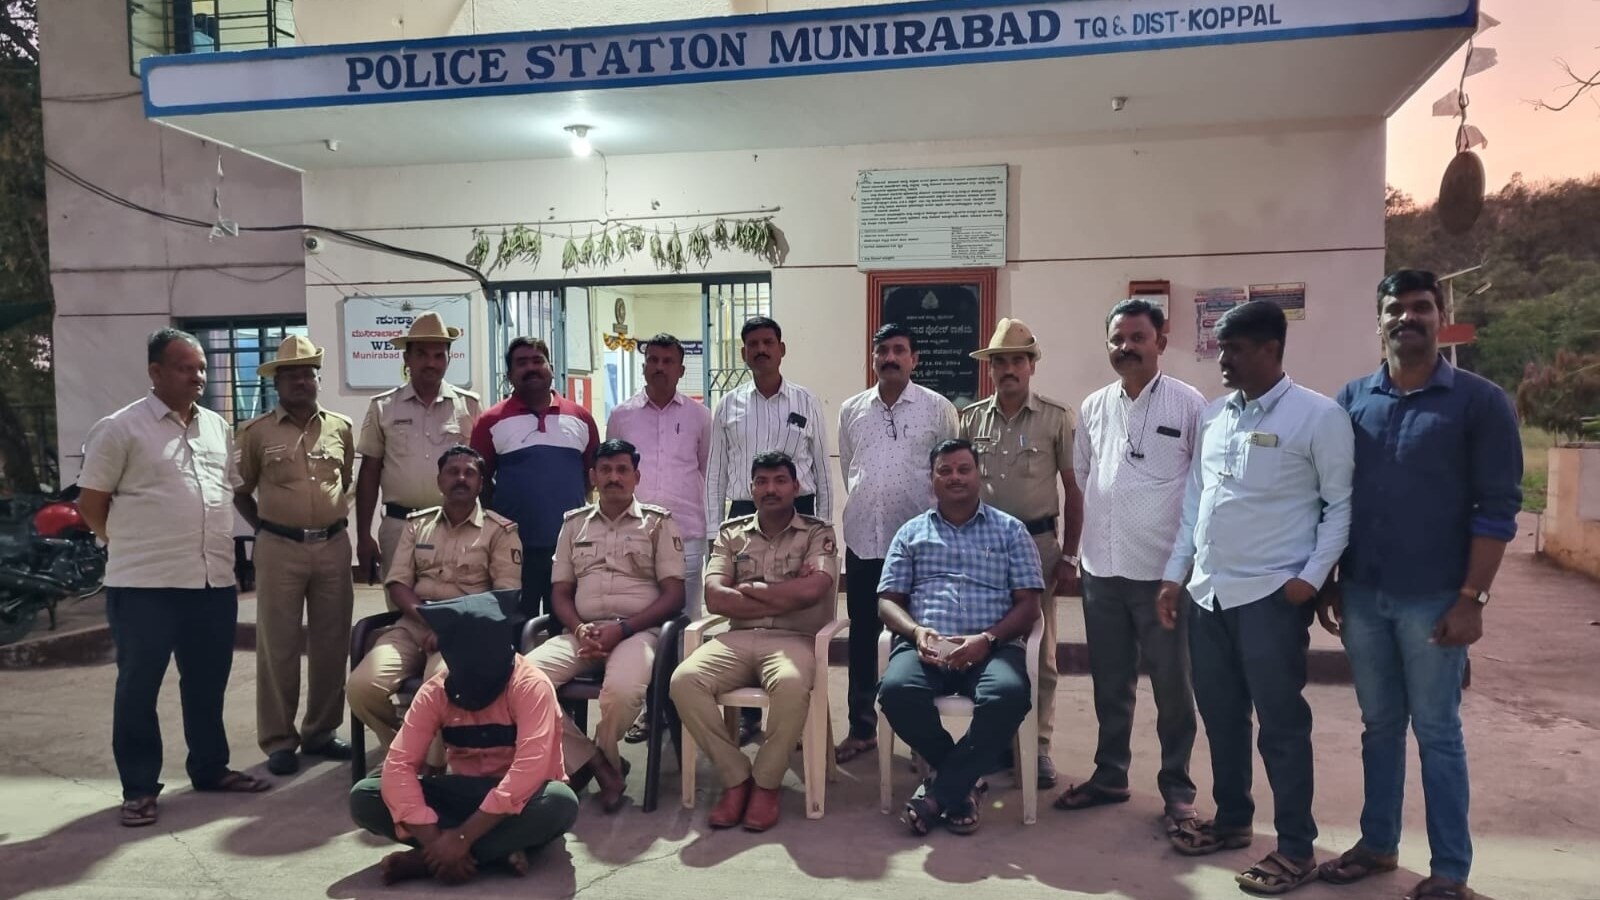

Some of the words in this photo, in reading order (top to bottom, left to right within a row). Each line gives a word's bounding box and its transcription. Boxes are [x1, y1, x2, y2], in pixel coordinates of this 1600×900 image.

[346, 48, 508, 93] POLICE
[525, 32, 748, 81] STATION
[768, 9, 1061, 64] MUNIRABAD
[1074, 18, 1108, 40] TQ
[1112, 16, 1128, 35] &
[352, 351, 400, 359] Munirabad
